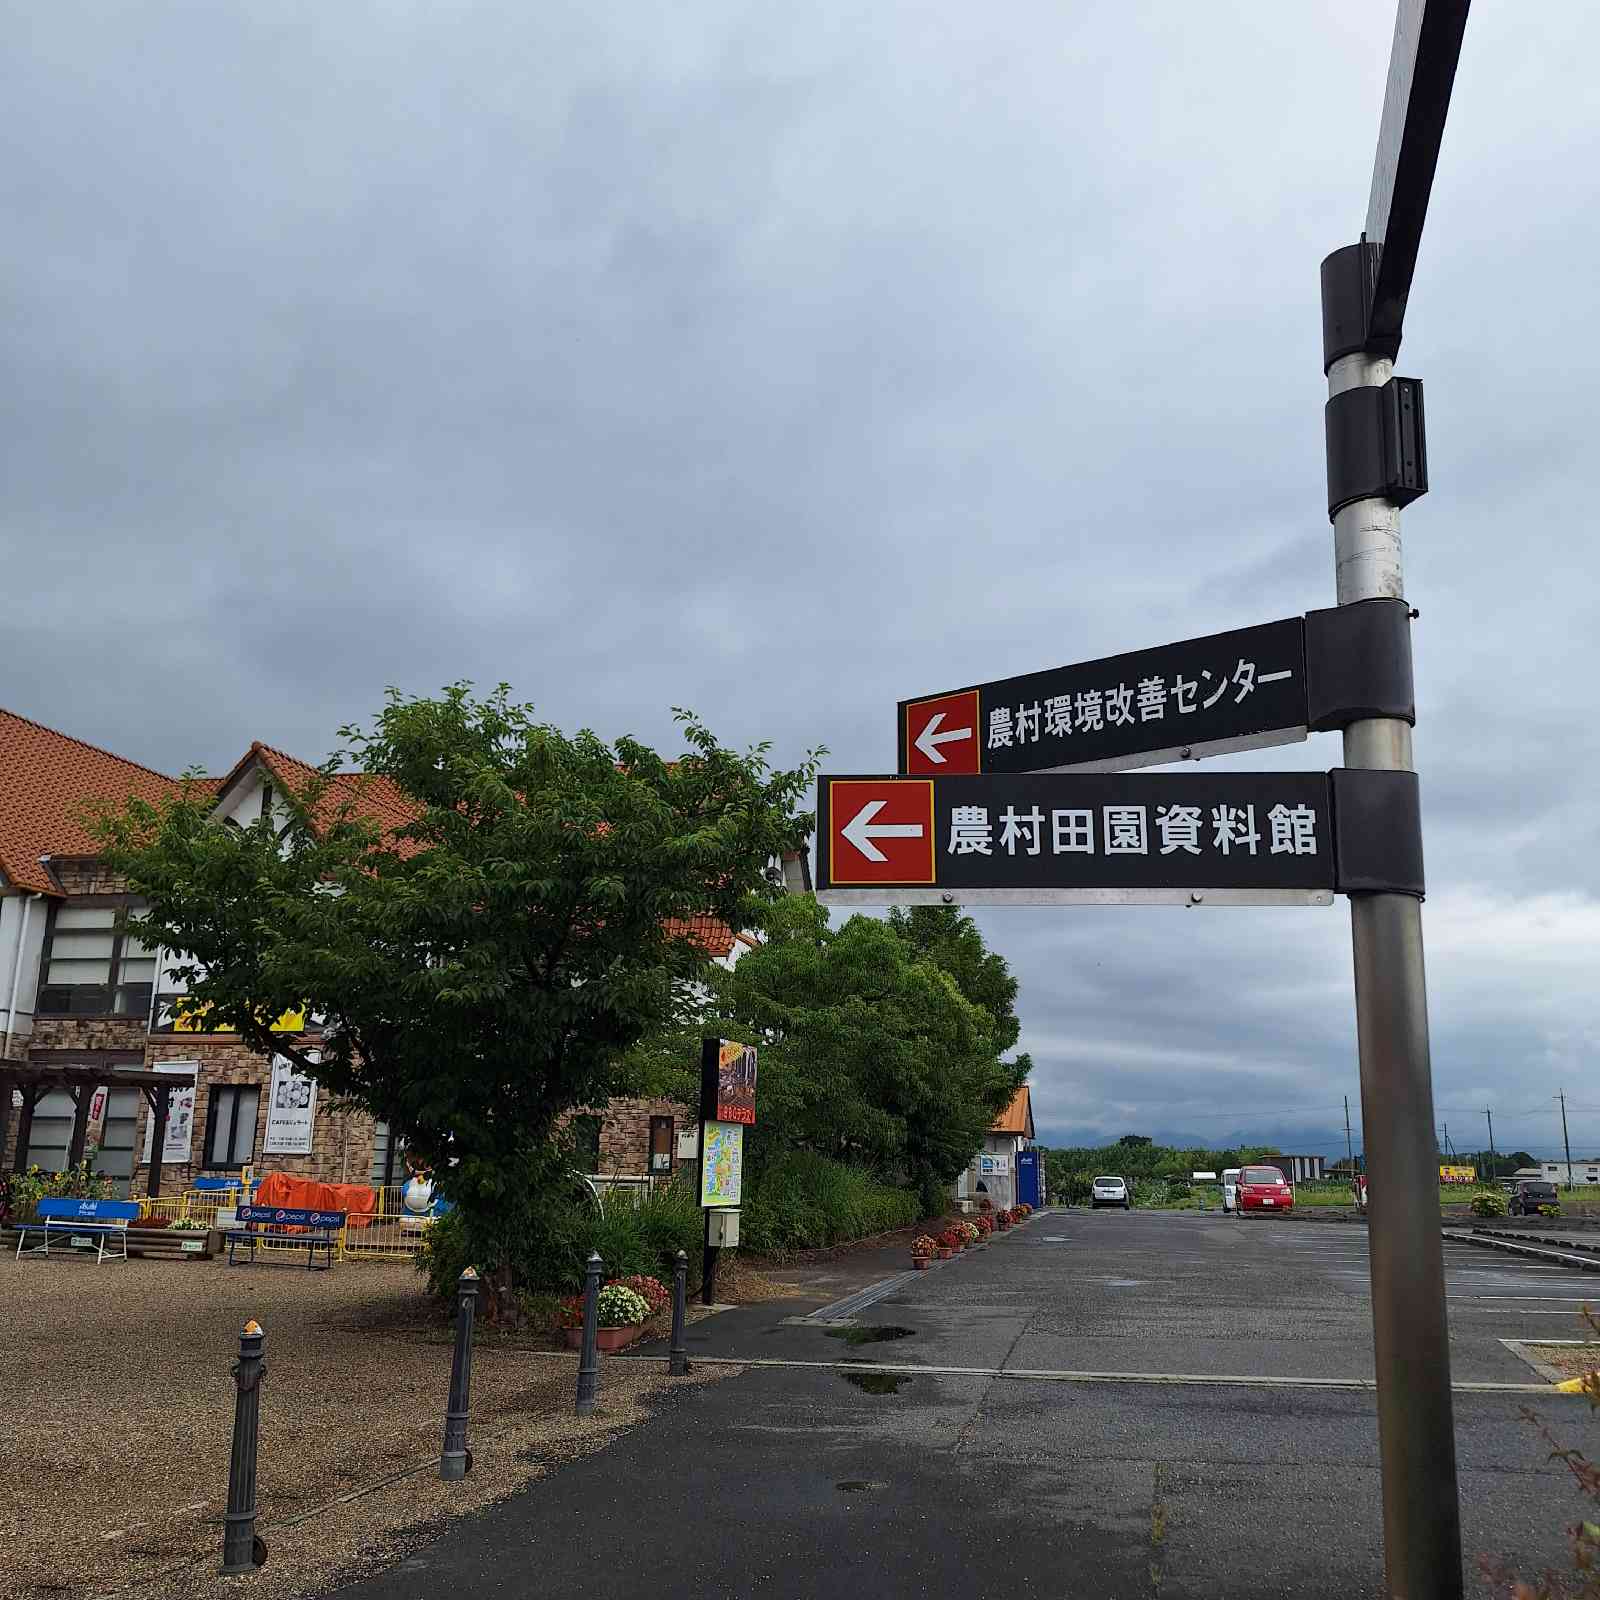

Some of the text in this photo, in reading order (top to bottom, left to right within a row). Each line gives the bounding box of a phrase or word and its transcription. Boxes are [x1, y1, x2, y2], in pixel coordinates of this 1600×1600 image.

[987, 657, 1293, 751] 農村環境改善センター
[946, 803, 1318, 857] 農村田園資料館
